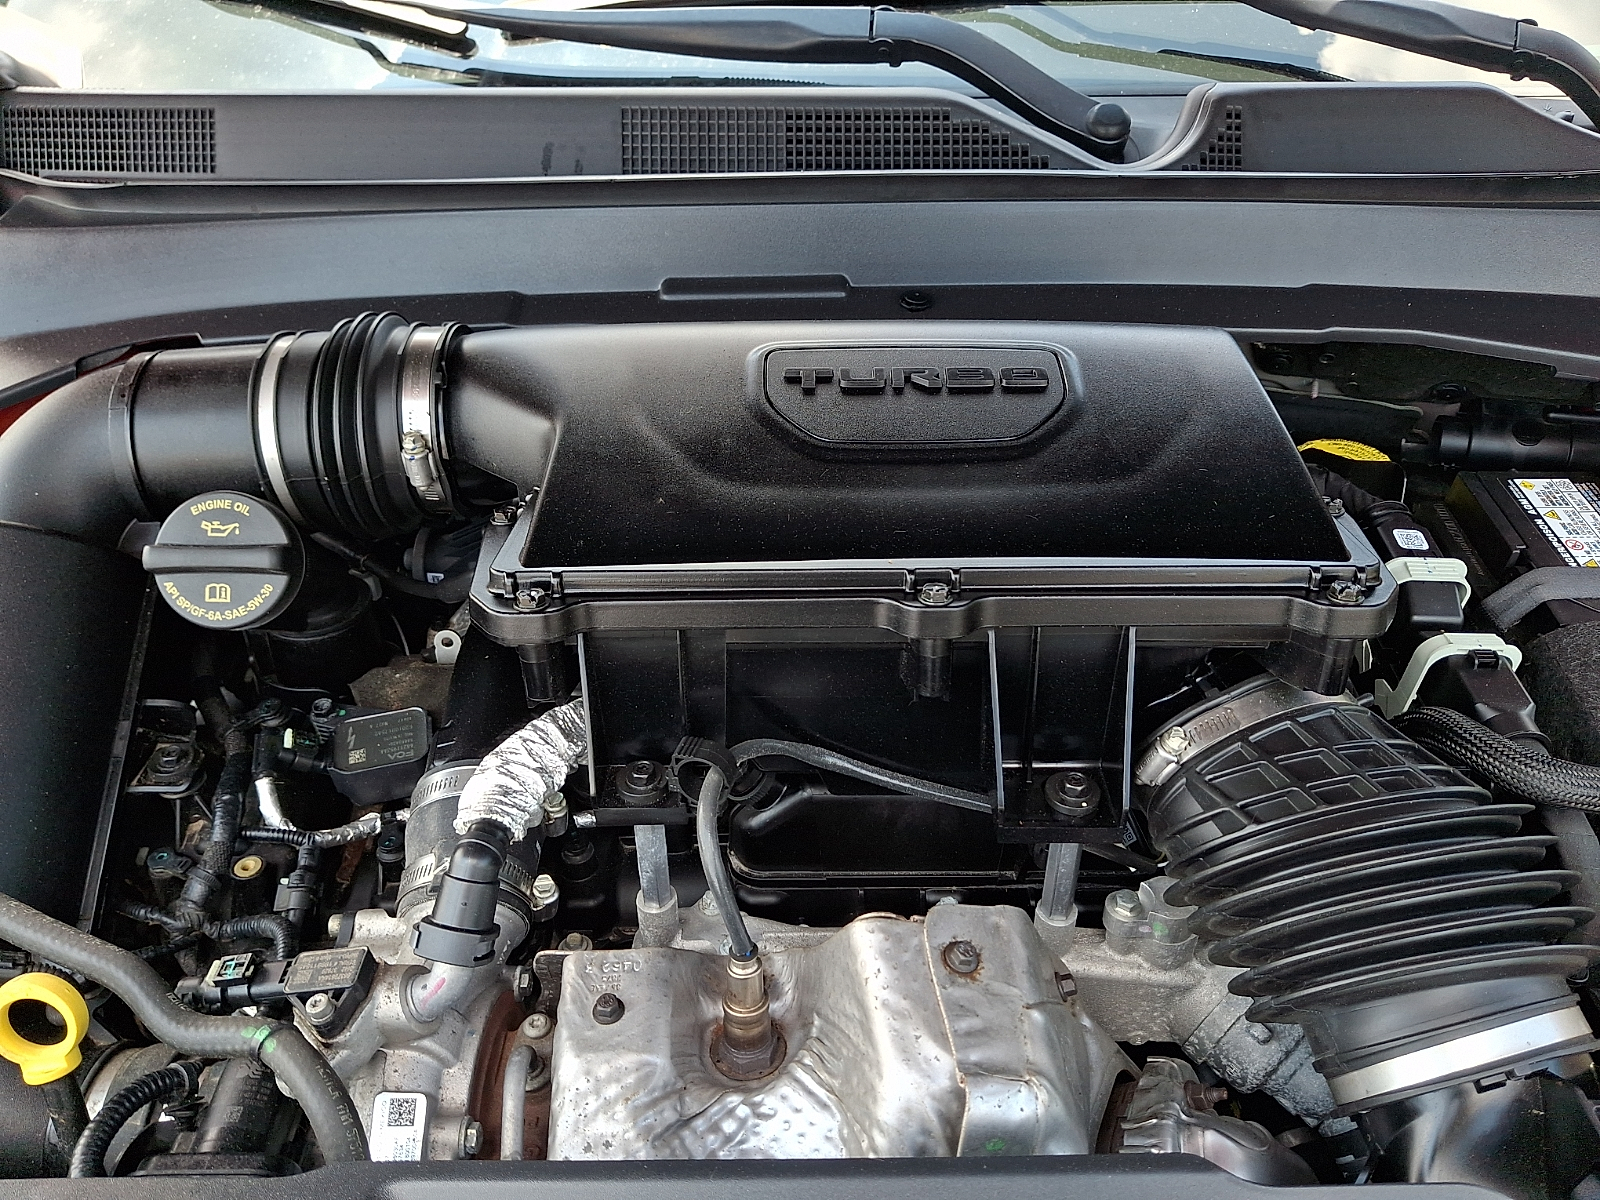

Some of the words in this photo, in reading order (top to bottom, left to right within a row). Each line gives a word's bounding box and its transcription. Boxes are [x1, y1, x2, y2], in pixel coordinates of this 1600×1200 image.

[783, 366, 1049, 395] TURBO
[190, 499, 232, 516] ENGINE
[233, 502, 251, 517] OIL
[164, 580, 180, 600] API
[387, 749, 414, 760] FCA
